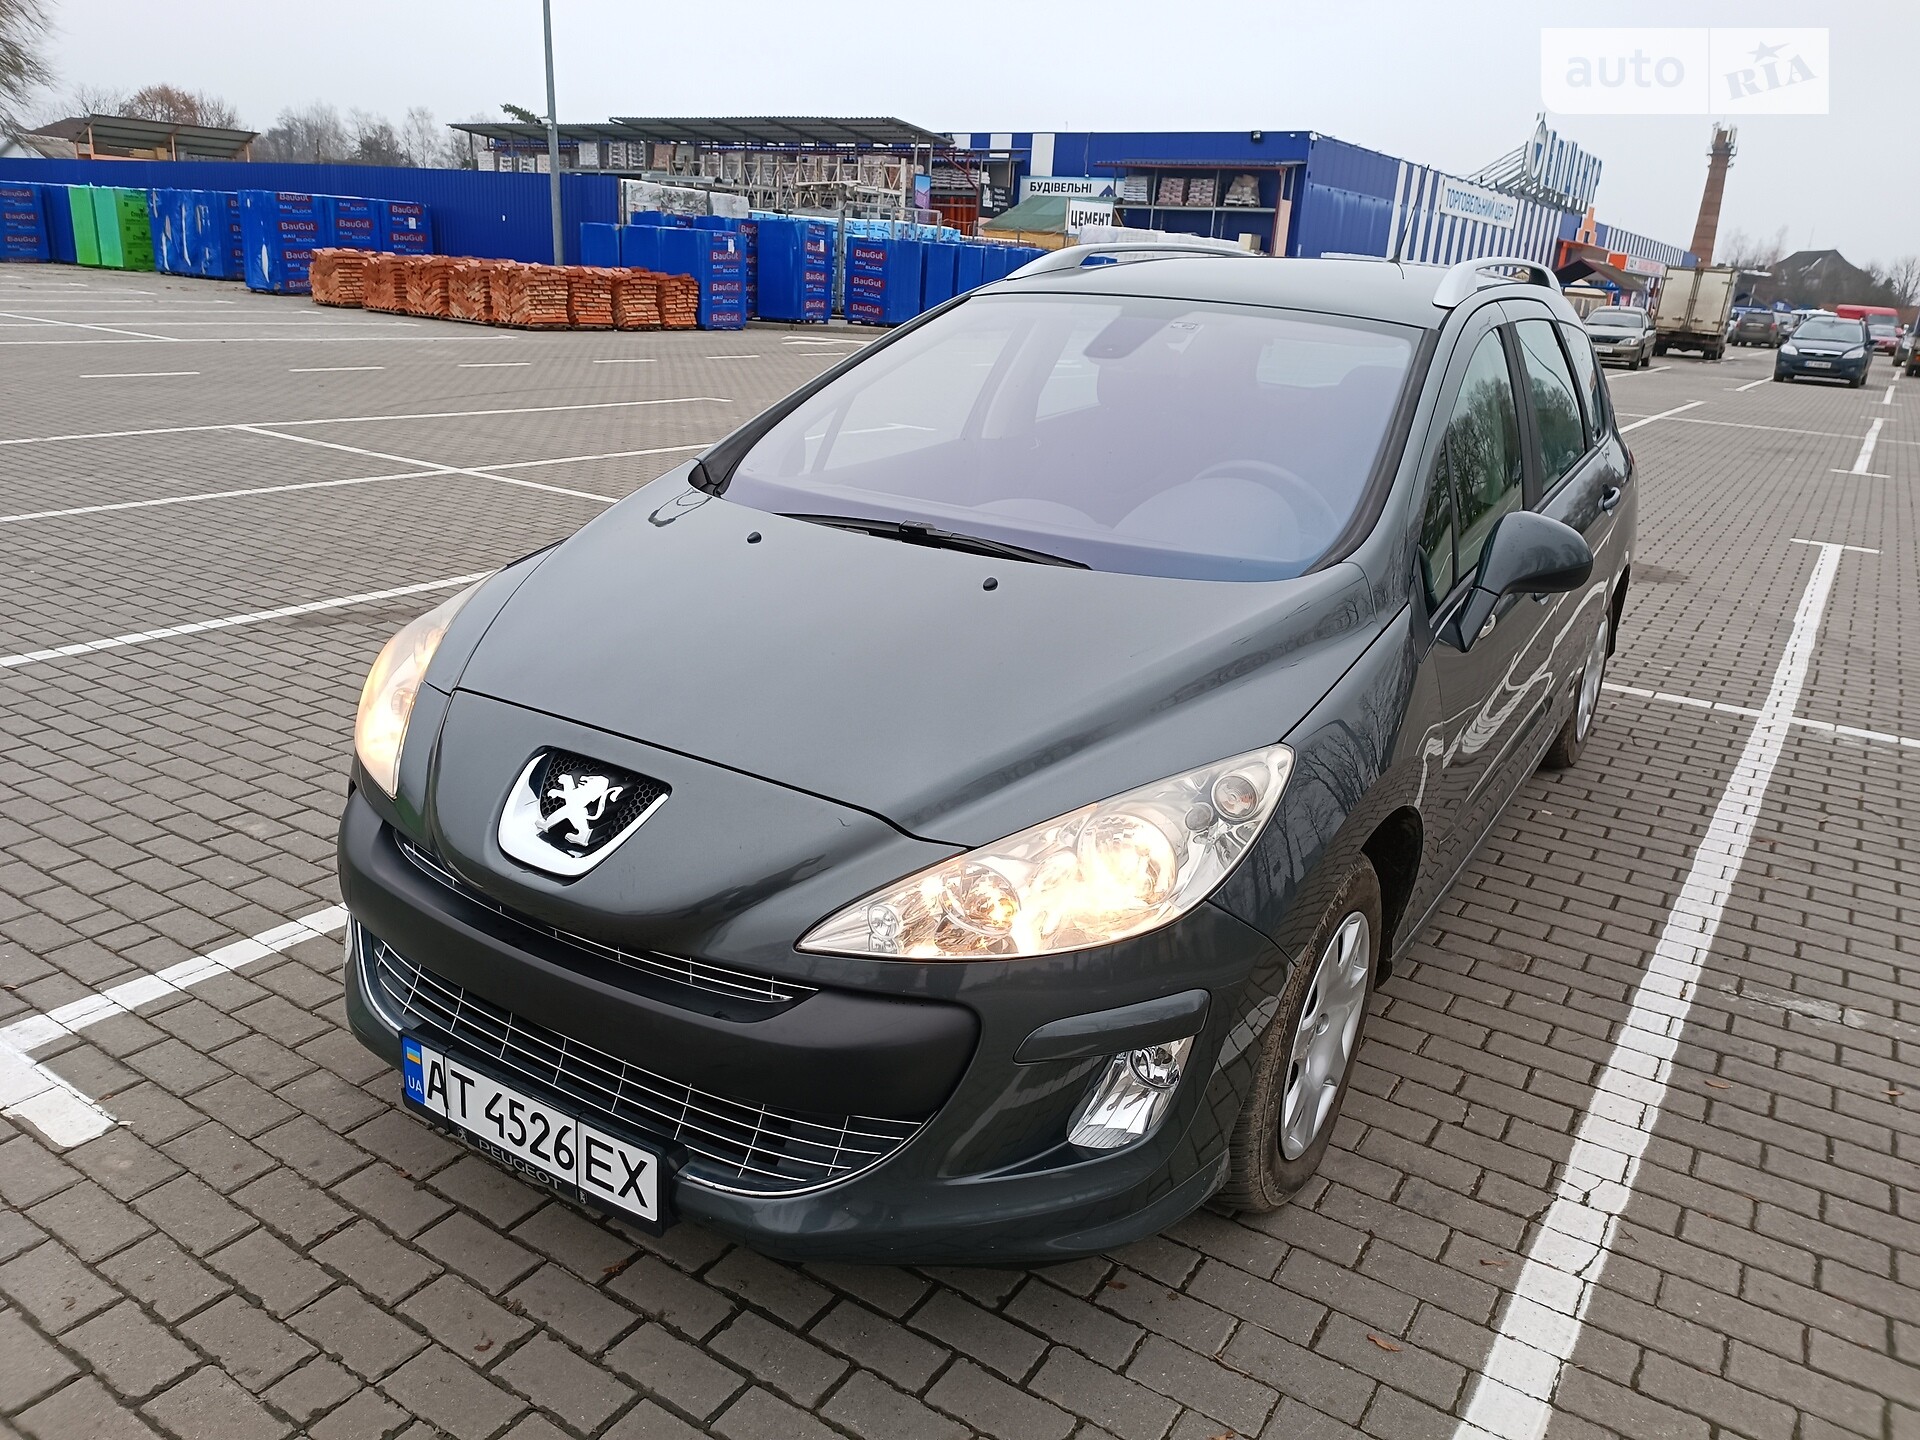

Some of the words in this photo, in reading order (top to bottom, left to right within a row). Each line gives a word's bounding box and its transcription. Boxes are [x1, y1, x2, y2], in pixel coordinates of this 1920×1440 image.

[1030, 182, 1092, 193] БУДІВЕЛЬНІ
[392, 205, 419, 214] BauGut
[1070, 210, 1111, 227] ЦЕМЕНТ
[281, 223, 315, 231] BauGut
[339, 220, 370, 228] BauGut
[393, 234, 423, 242] BauGut
[713, 252, 739, 260] BauGut
[856, 250, 883, 260] BauGut
[806, 273, 825, 281] BauGut
[713, 283, 739, 291] BauGut
[853, 277, 881, 288] BauGut
[806, 301, 825, 309] BauGut
[852, 304, 880, 314] BauGut
[408, 1075, 423, 1095] UA
[427, 1060, 475, 1119] AT
[484, 1091, 575, 1171] 4526
[585, 1134, 649, 1209] EX
[478, 1138, 563, 1190] PEUGEOT
